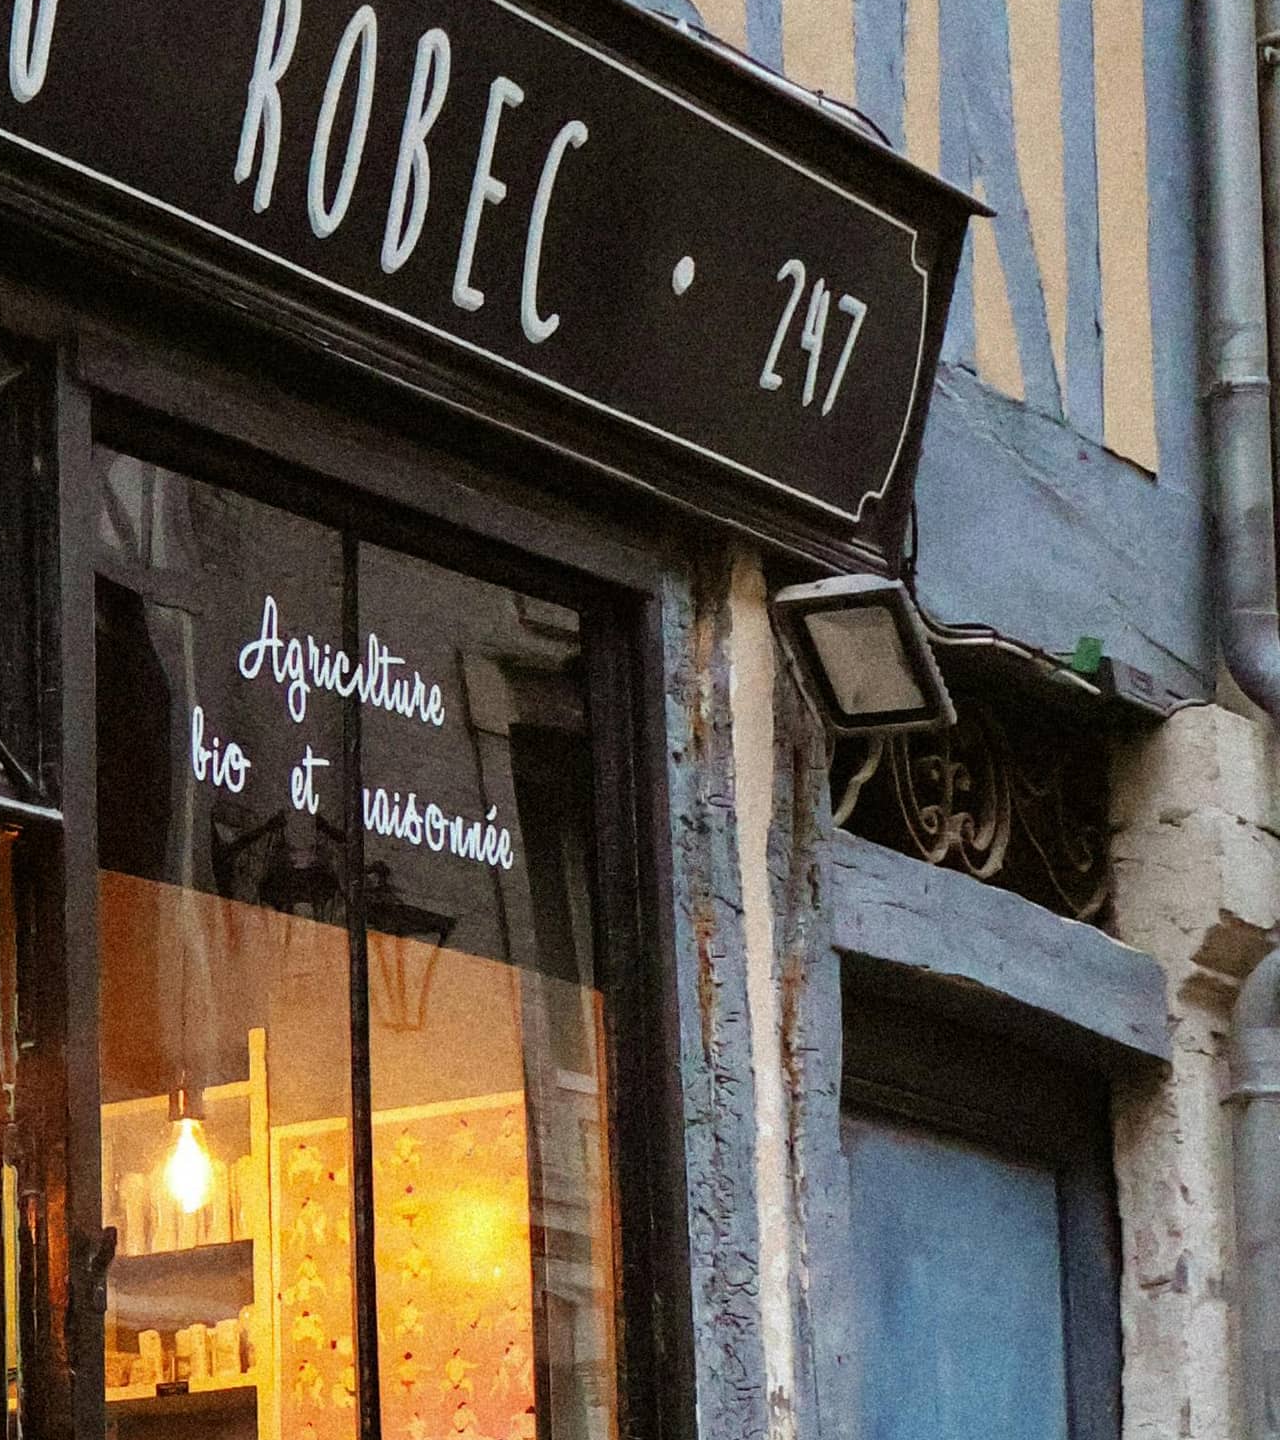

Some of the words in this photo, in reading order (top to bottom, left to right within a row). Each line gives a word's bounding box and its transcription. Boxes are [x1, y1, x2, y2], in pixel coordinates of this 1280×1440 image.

[758, 259, 868, 416] 247
[191, 704, 251, 793] bio
[290, 744, 330, 815] et
